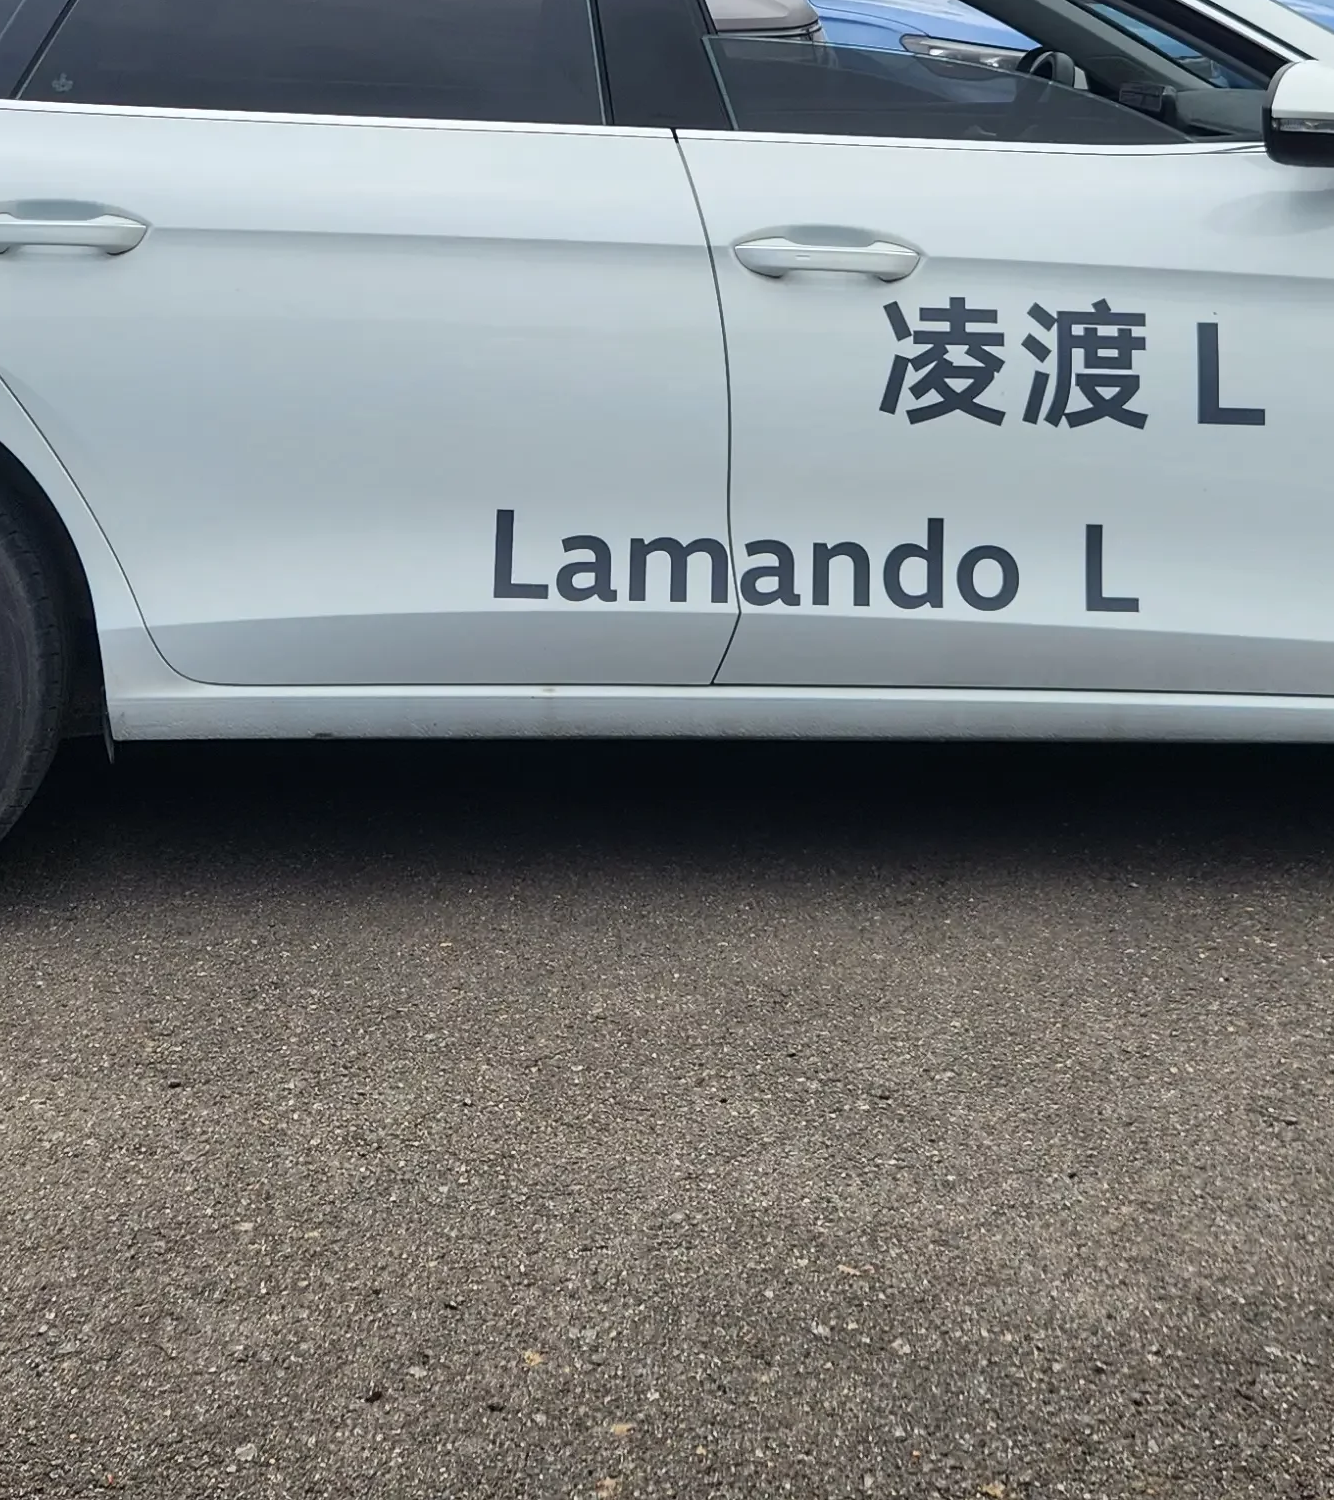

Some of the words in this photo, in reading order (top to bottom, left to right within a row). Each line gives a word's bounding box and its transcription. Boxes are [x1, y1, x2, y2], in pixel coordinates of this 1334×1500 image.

[878, 296, 1150, 430] 凌渡
[1196, 321, 1268, 427] L
[492, 508, 1021, 612] Lamando
[1084, 523, 1141, 613] L
